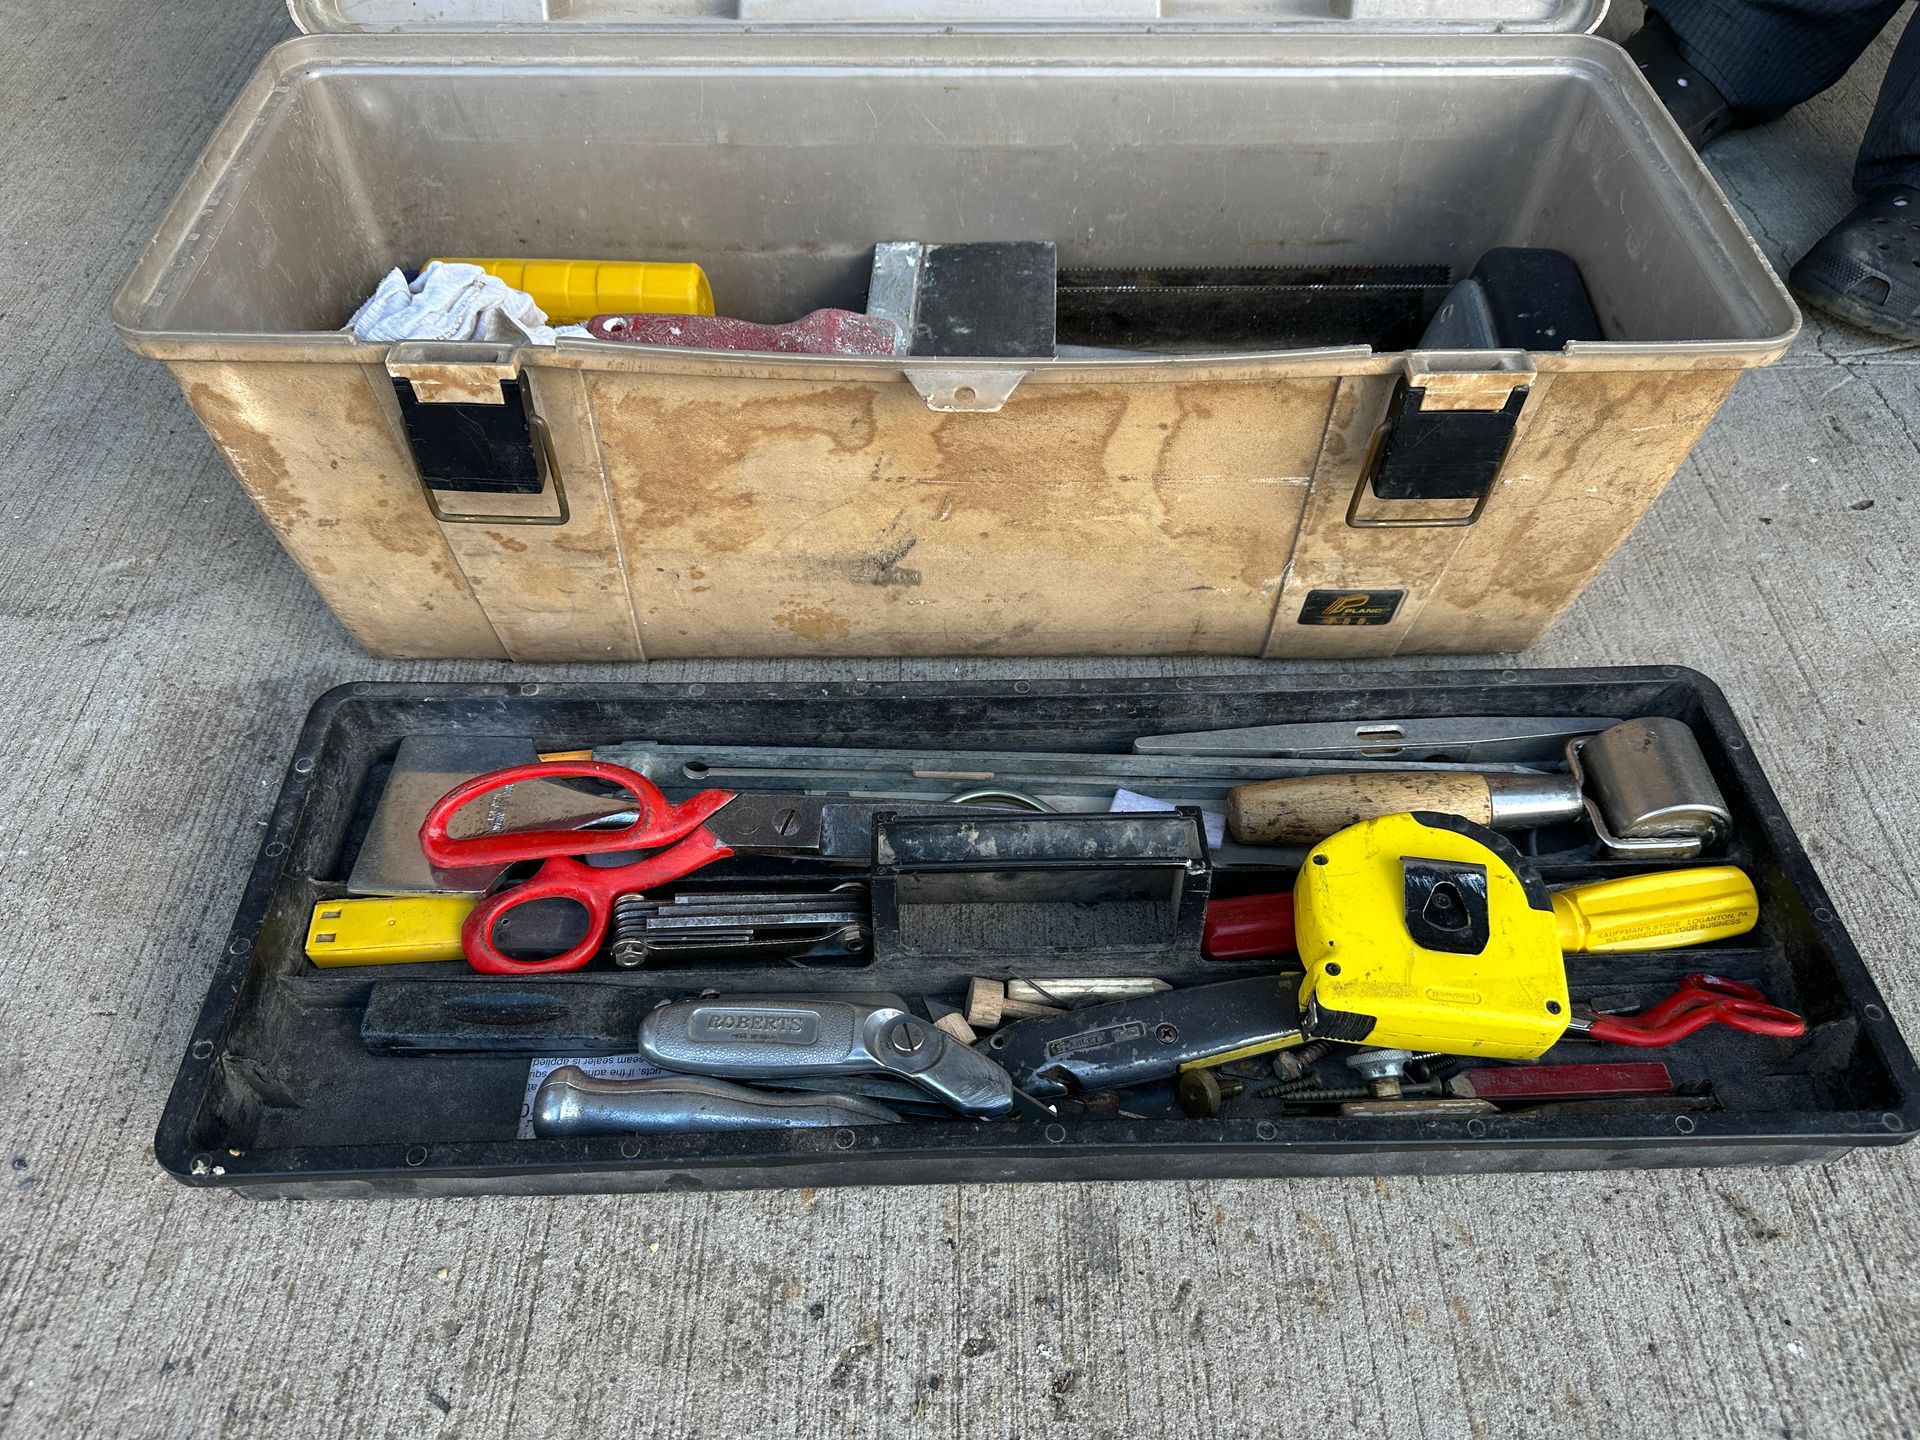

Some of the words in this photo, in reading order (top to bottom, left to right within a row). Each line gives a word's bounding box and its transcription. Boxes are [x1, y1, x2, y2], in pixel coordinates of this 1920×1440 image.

[1597, 925, 1651, 938] KAUFFMAN'S
[1652, 920, 1681, 930] STORE
[1620, 928, 1673, 942] APPRECIATE
[1674, 924, 1698, 933] YOUR
[1700, 918, 1741, 930] BUSINESS
[707, 1014, 805, 1032] ROBERTS
[532, 1057, 570, 1066] applied
[572, 1057, 583, 1066] is
[584, 1056, 615, 1065] sealer
[617, 1056, 645, 1064] seam
[608, 1068, 627, 1078] the
[628, 1067, 636, 1077] if
